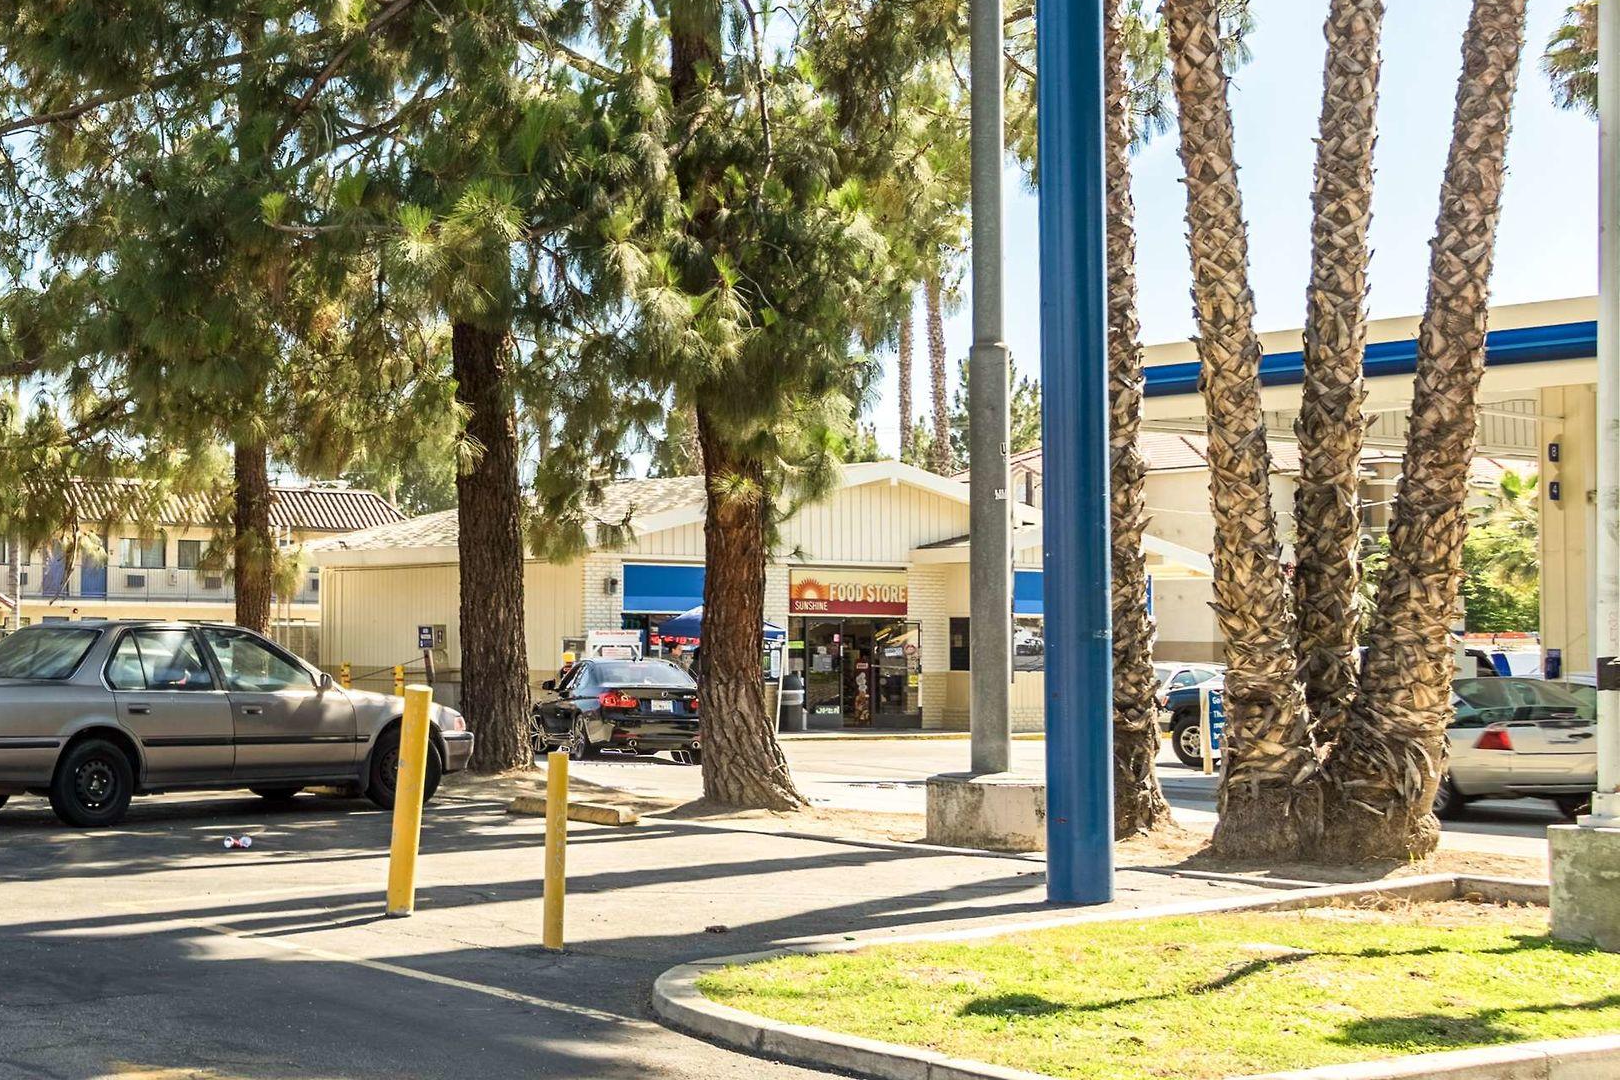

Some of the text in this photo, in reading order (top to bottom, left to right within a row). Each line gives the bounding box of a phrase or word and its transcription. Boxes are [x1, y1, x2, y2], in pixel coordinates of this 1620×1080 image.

[829, 583, 907, 603] FOOD STORE
[794, 600, 829, 611] SUNSHINE
[815, 705, 840, 714] OPEN
